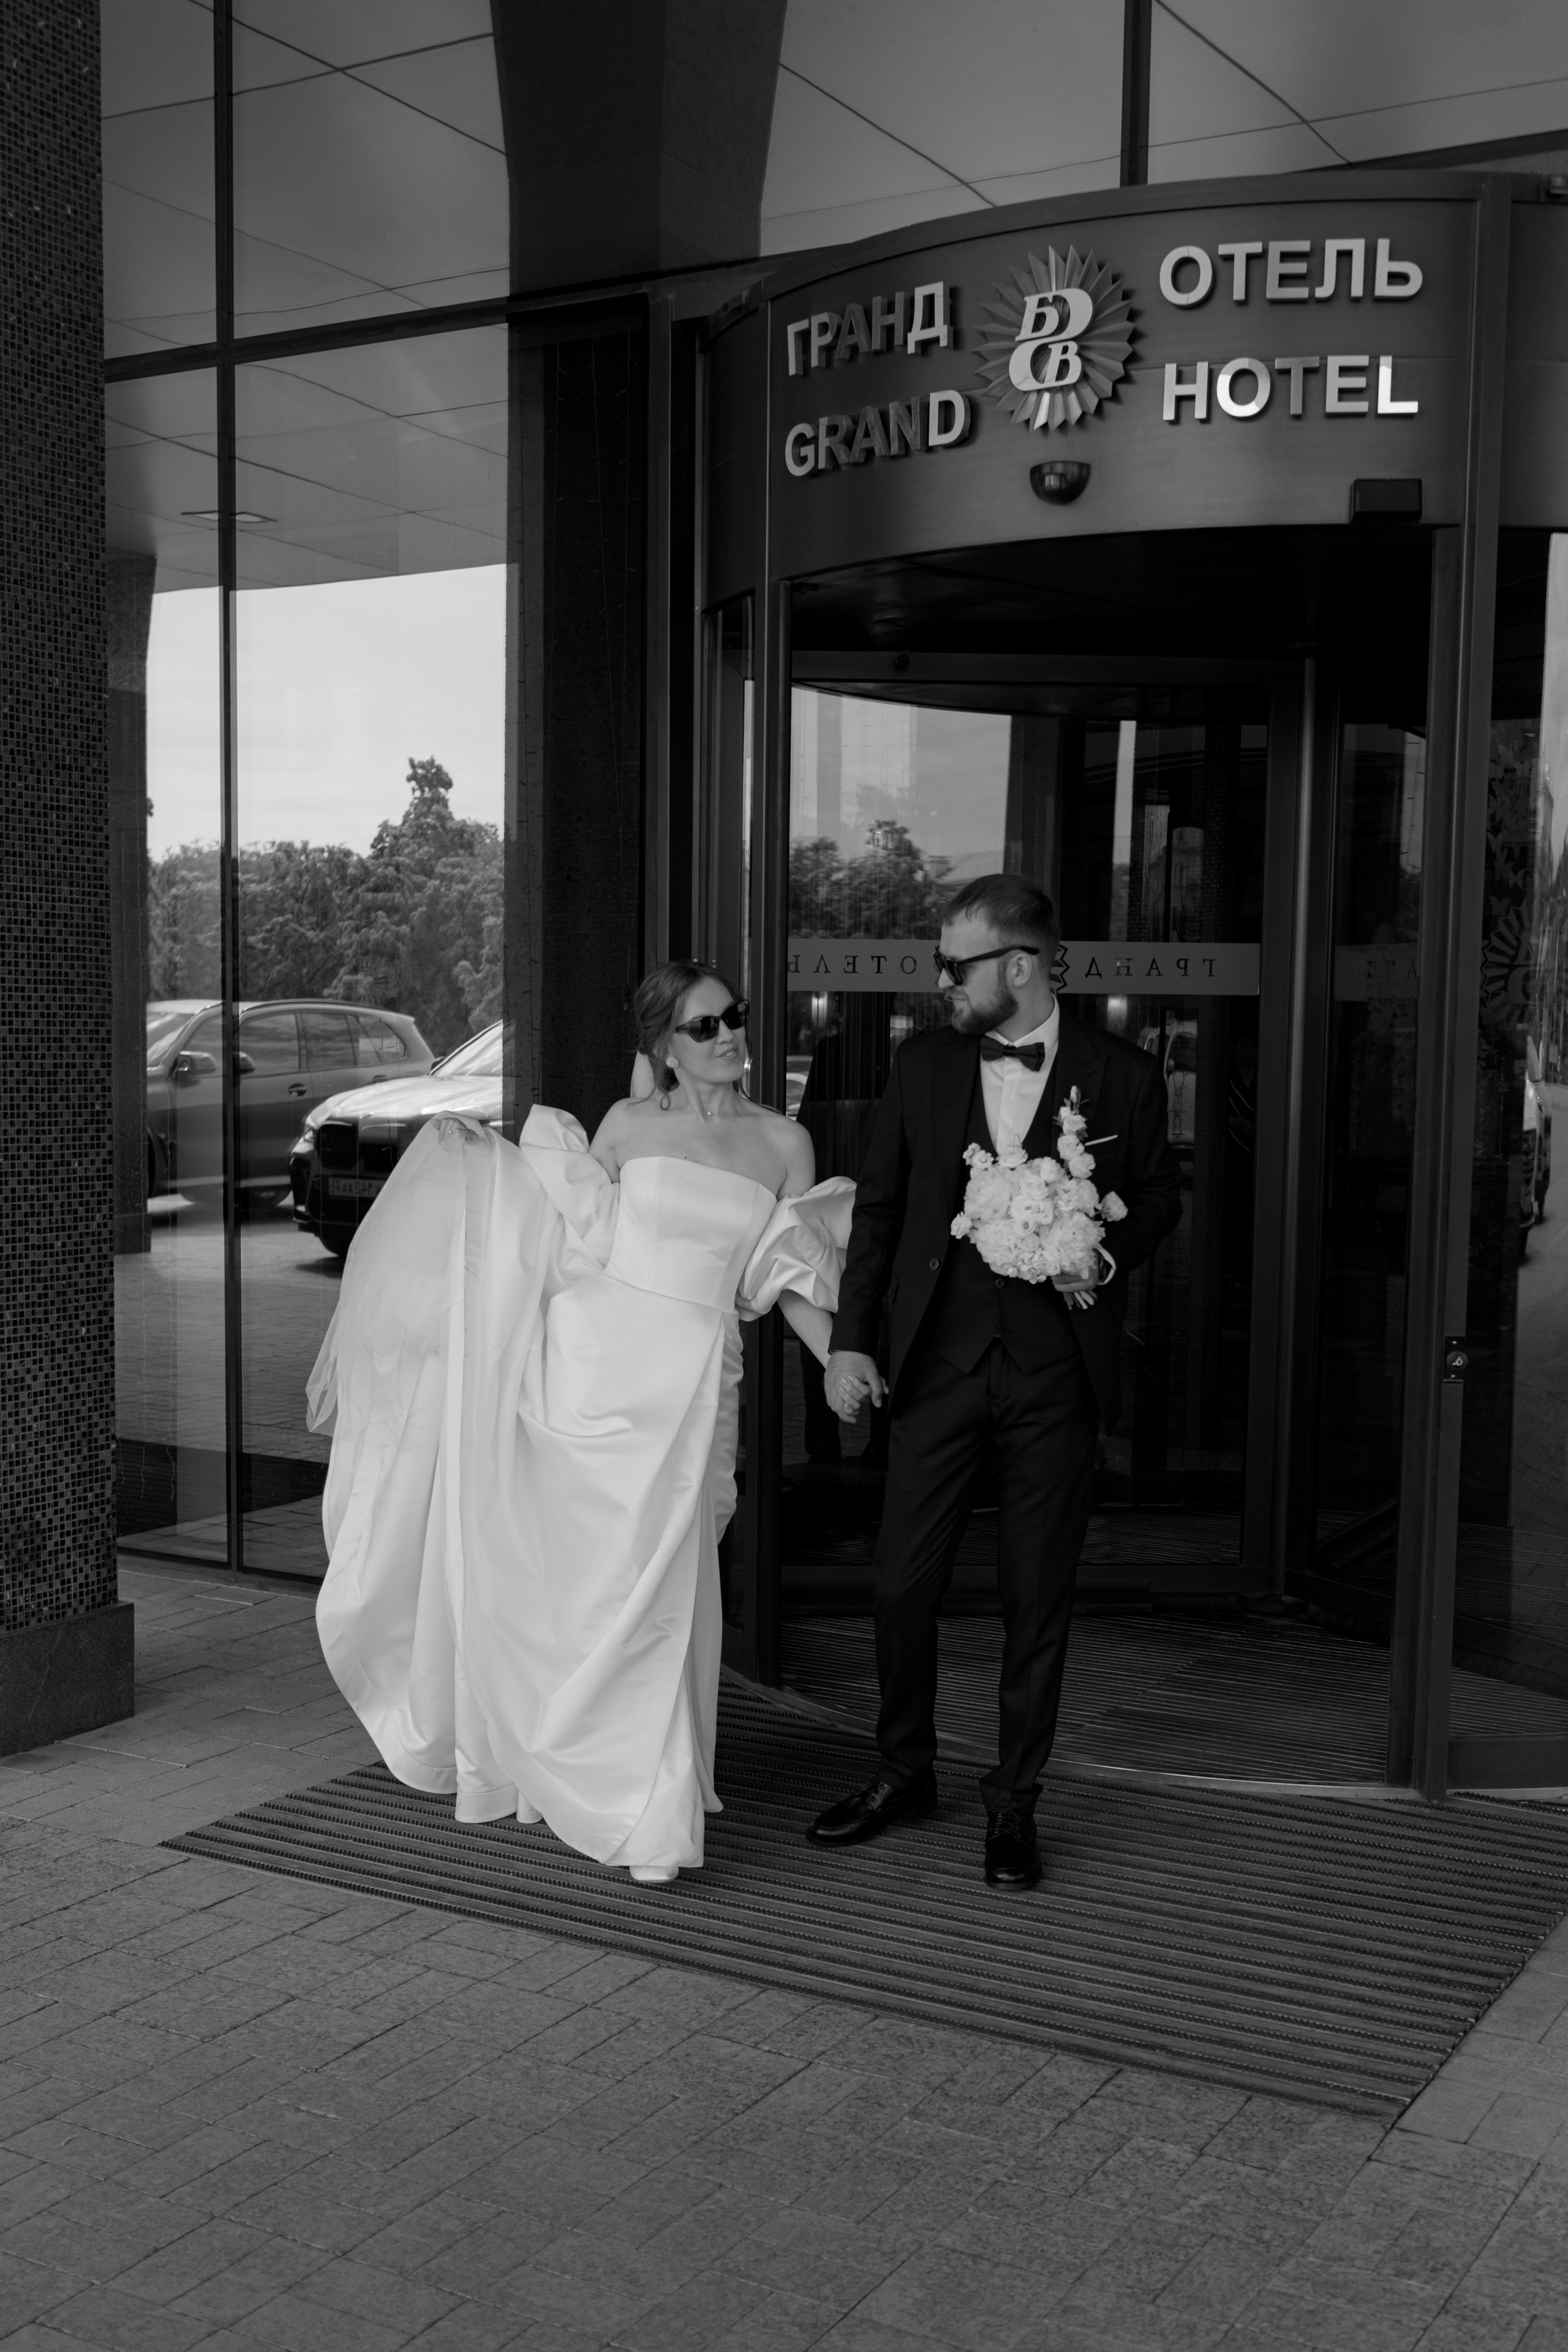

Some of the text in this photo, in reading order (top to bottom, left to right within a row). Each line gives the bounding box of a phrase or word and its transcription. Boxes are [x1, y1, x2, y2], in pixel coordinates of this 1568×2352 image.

[787, 238, 1423, 376] ГРАНД ОТЕЛЬ
[785, 355, 1419, 477] GRAND HOTEL
